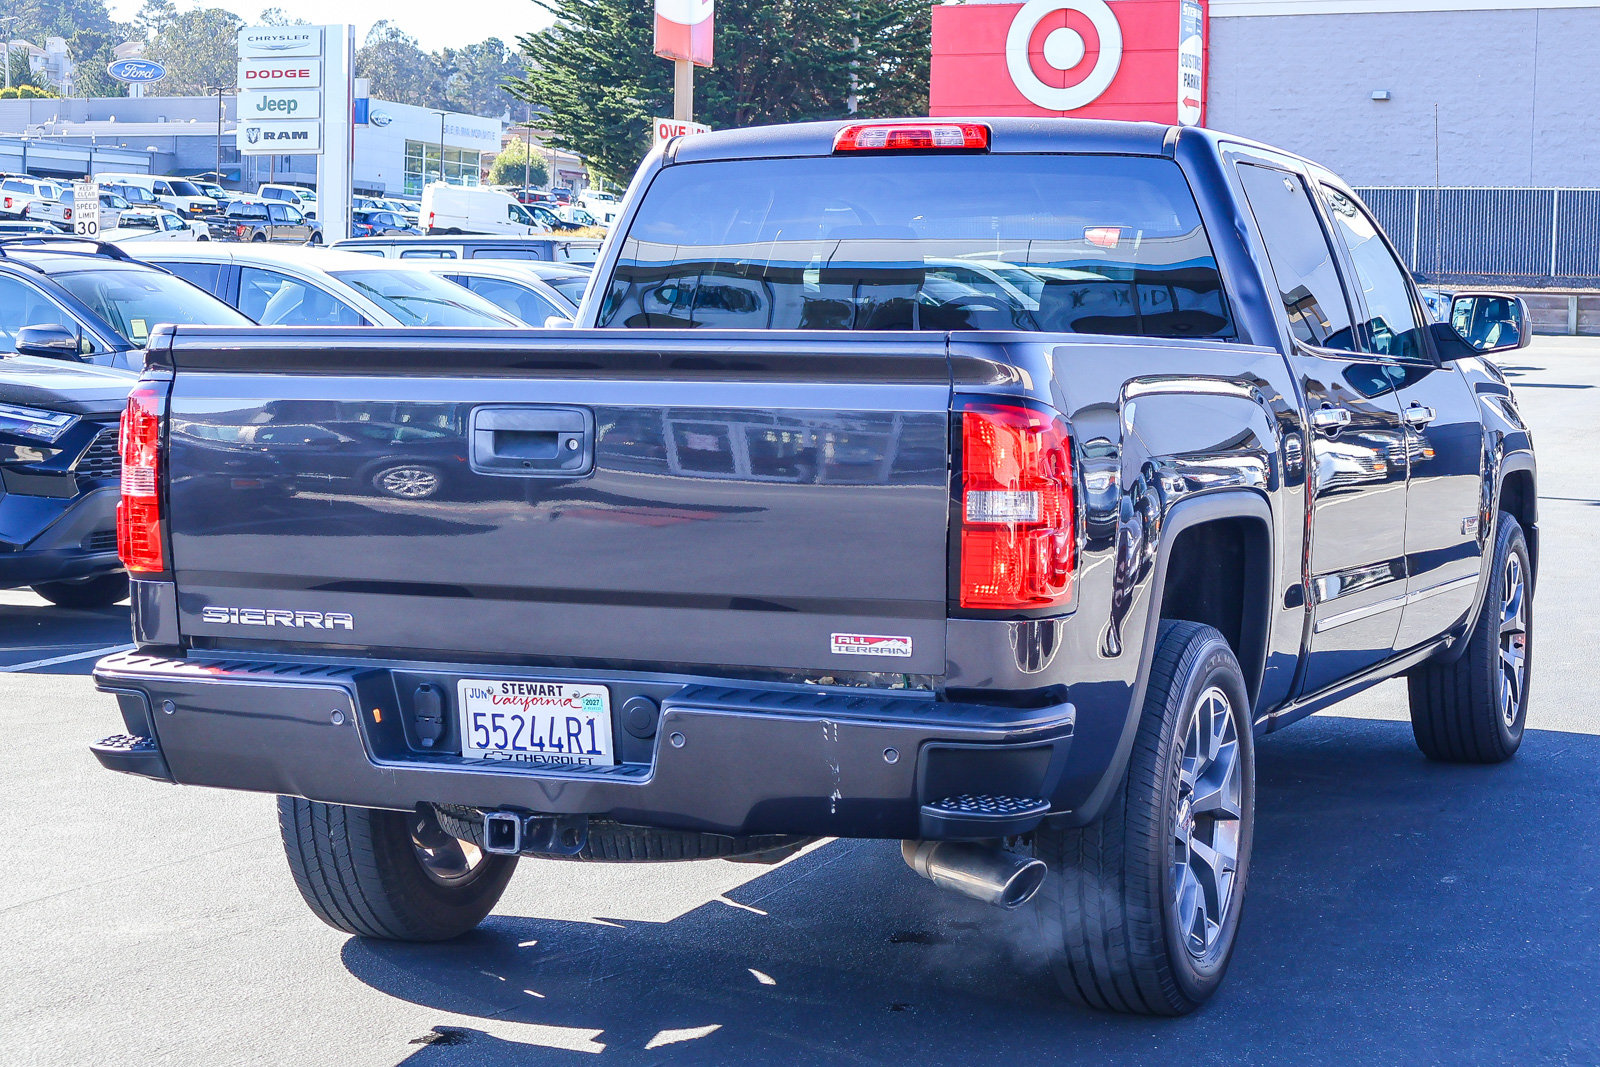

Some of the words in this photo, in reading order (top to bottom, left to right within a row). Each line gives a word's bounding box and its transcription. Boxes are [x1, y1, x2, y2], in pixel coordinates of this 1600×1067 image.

[247, 34, 310, 42] CHRYSLER
[121, 63, 155, 80] Ford
[245, 69, 310, 79] DODGE
[256, 95, 298, 114] Jeep
[263, 130, 309, 140] RAM
[77, 221, 97, 235] 30
[203, 606, 354, 630] SIERRA
[838, 636, 869, 645] ALL
[835, 646, 907, 654] TERRAIN
[469, 688, 488, 700] JUN
[501, 682, 564, 697] STEWART
[492, 694, 583, 712] California
[585, 698, 600, 706] 2027
[473, 712, 602, 755] 55244R1
[515, 753, 594, 766] CHEVROLET
